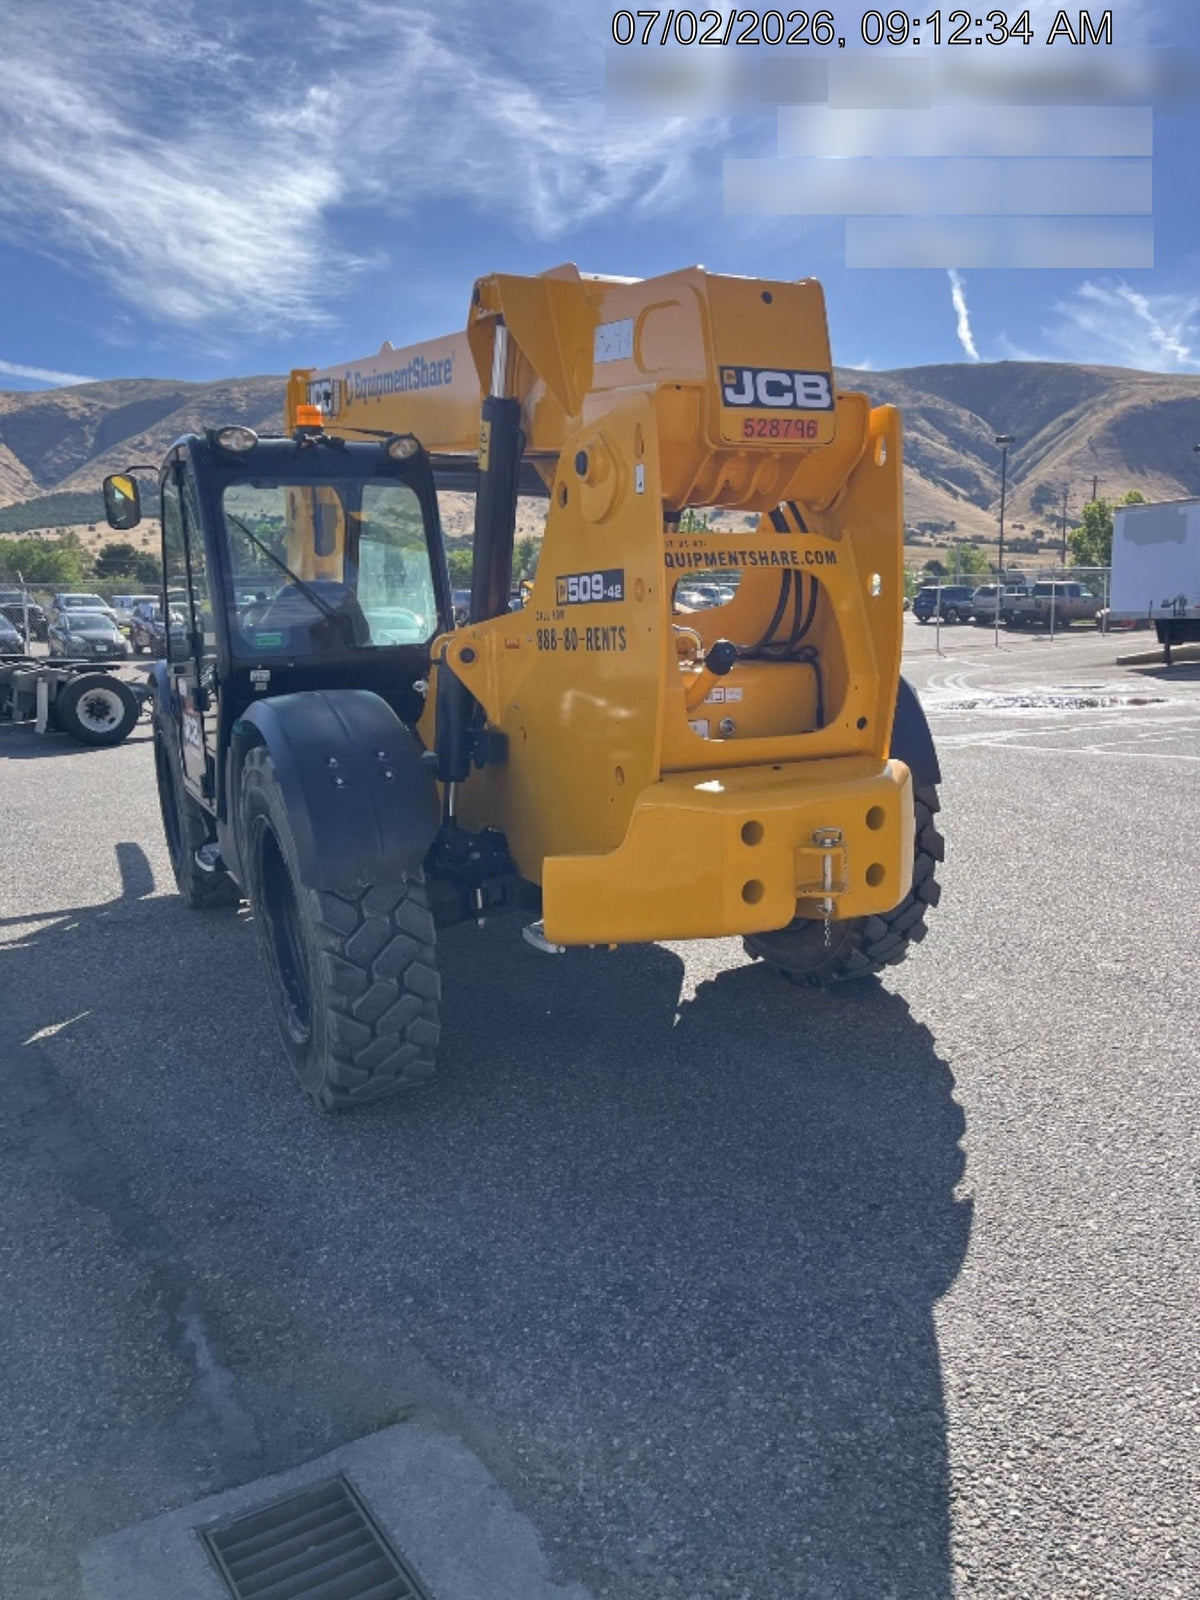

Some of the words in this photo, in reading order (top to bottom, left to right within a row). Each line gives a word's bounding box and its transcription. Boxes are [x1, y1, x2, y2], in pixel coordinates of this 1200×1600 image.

[354, 356, 453, 404] EquipmentShare
[724, 370, 831, 408] JCB
[743, 418, 819, 439] 528796
[664, 550, 838, 569] QUIPMENTSHARE.COM
[567, 573, 623, 602] 509-42
[536, 625, 627, 652] 888-80-RENTS
